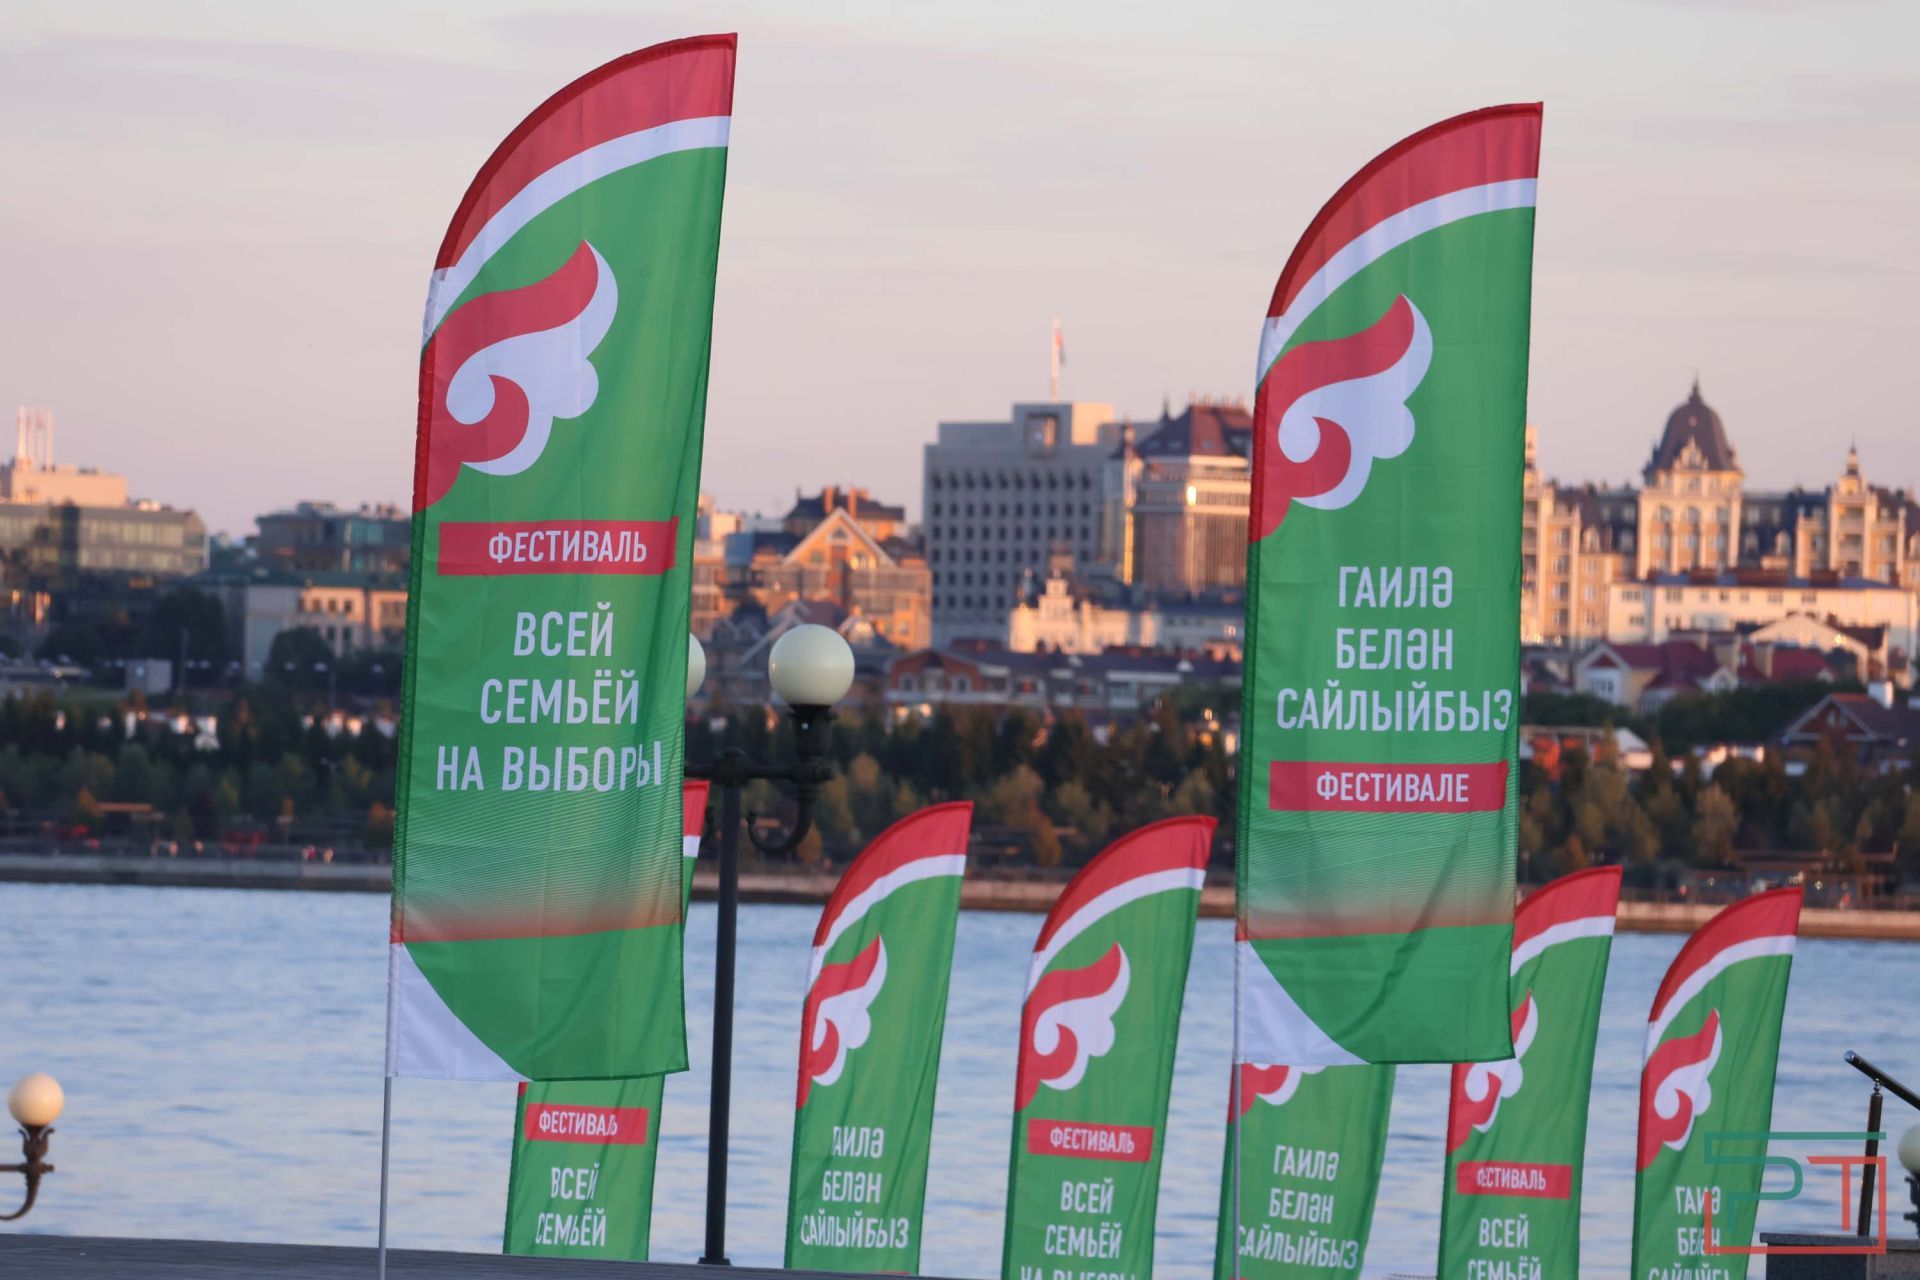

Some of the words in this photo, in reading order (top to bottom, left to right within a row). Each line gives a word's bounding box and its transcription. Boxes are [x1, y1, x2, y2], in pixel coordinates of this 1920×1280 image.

[488, 530, 647, 563] ФЕСТИВАЛЬ
[1338, 566, 1453, 608] ГАИЛӘ
[513, 601, 614, 657] ВСЕЙ
[1336, 628, 1453, 670] БЕЛӘН
[480, 669, 639, 724] СЕМЬЁЙ
[1276, 679, 1512, 731] САЙЛЫЙБЫЗ
[436, 745, 484, 791] НА
[502, 741, 662, 791] ВЫБОРЫ
[1316, 771, 1469, 802] ФЕСТИВАЛЕ
[1050, 1126, 1135, 1154] ФЕСТИВАЛЬ
[551, 1162, 600, 1200] ВСЕЙ
[1273, 1144, 1340, 1182] ГАИЛӘ
[822, 1170, 882, 1203] БЕЛӘН
[1060, 1177, 1115, 1215] ВСЕЙ
[1268, 1187, 1335, 1224] БЕЛӘН
[535, 1207, 607, 1247] СЕМЬЁЙ
[800, 1208, 910, 1249] САЙЛЫЙБЫЗ
[1044, 1222, 1123, 1259] СЕМЬЁЙ
[1479, 1213, 1530, 1249] ВСЕЙ
